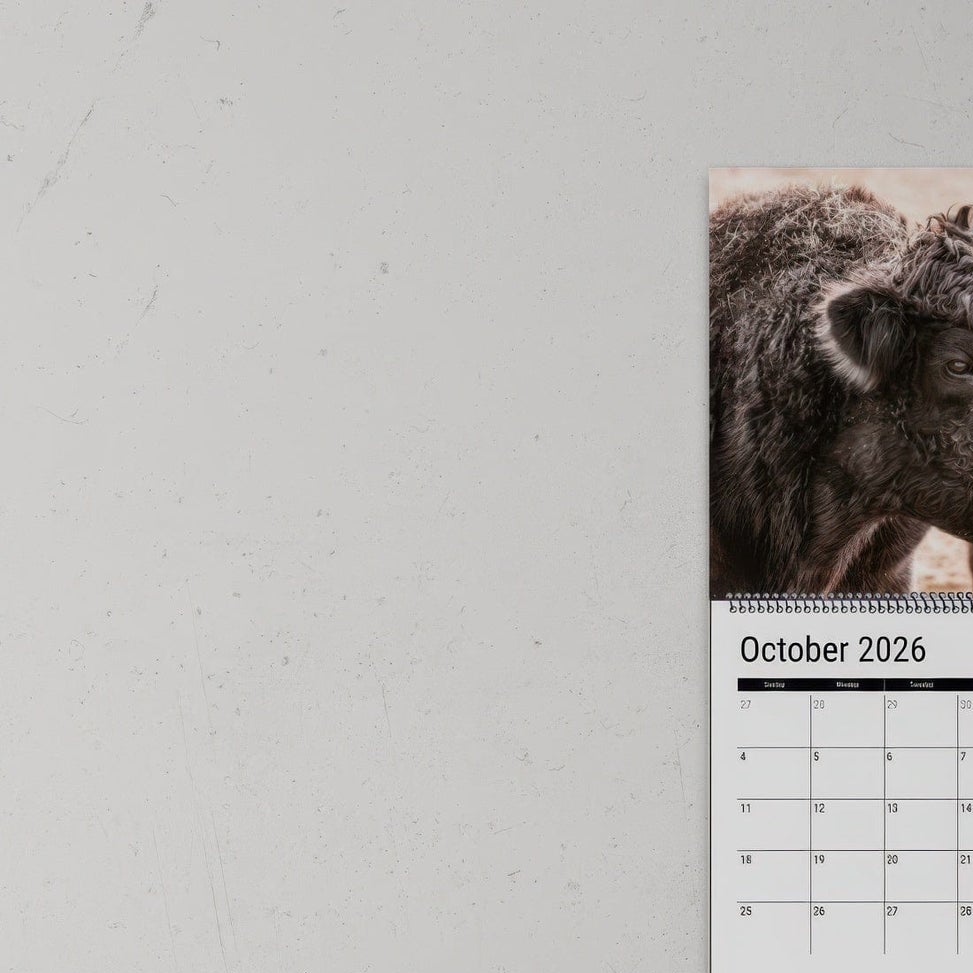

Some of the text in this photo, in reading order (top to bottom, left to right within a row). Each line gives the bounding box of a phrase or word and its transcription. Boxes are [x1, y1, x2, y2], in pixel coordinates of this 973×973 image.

[740, 634, 927, 663] October 2026
[741, 699, 752, 710] 27
[740, 751, 747, 761] 4
[814, 750, 820, 762] 5
[887, 751, 893, 762] 6
[961, 751, 967, 761] 7
[741, 803, 751, 814] 11
[814, 802, 826, 814] 12
[888, 802, 898, 814] 13
[961, 802, 973, 814] 14
[741, 854, 752, 865] 18
[814, 854, 826, 865] 19
[887, 853, 899, 865] 20
[960, 854, 971, 865] 21
[740, 905, 753, 917] 25
[813, 905, 826, 917] 26
[887, 905, 898, 917] 27
